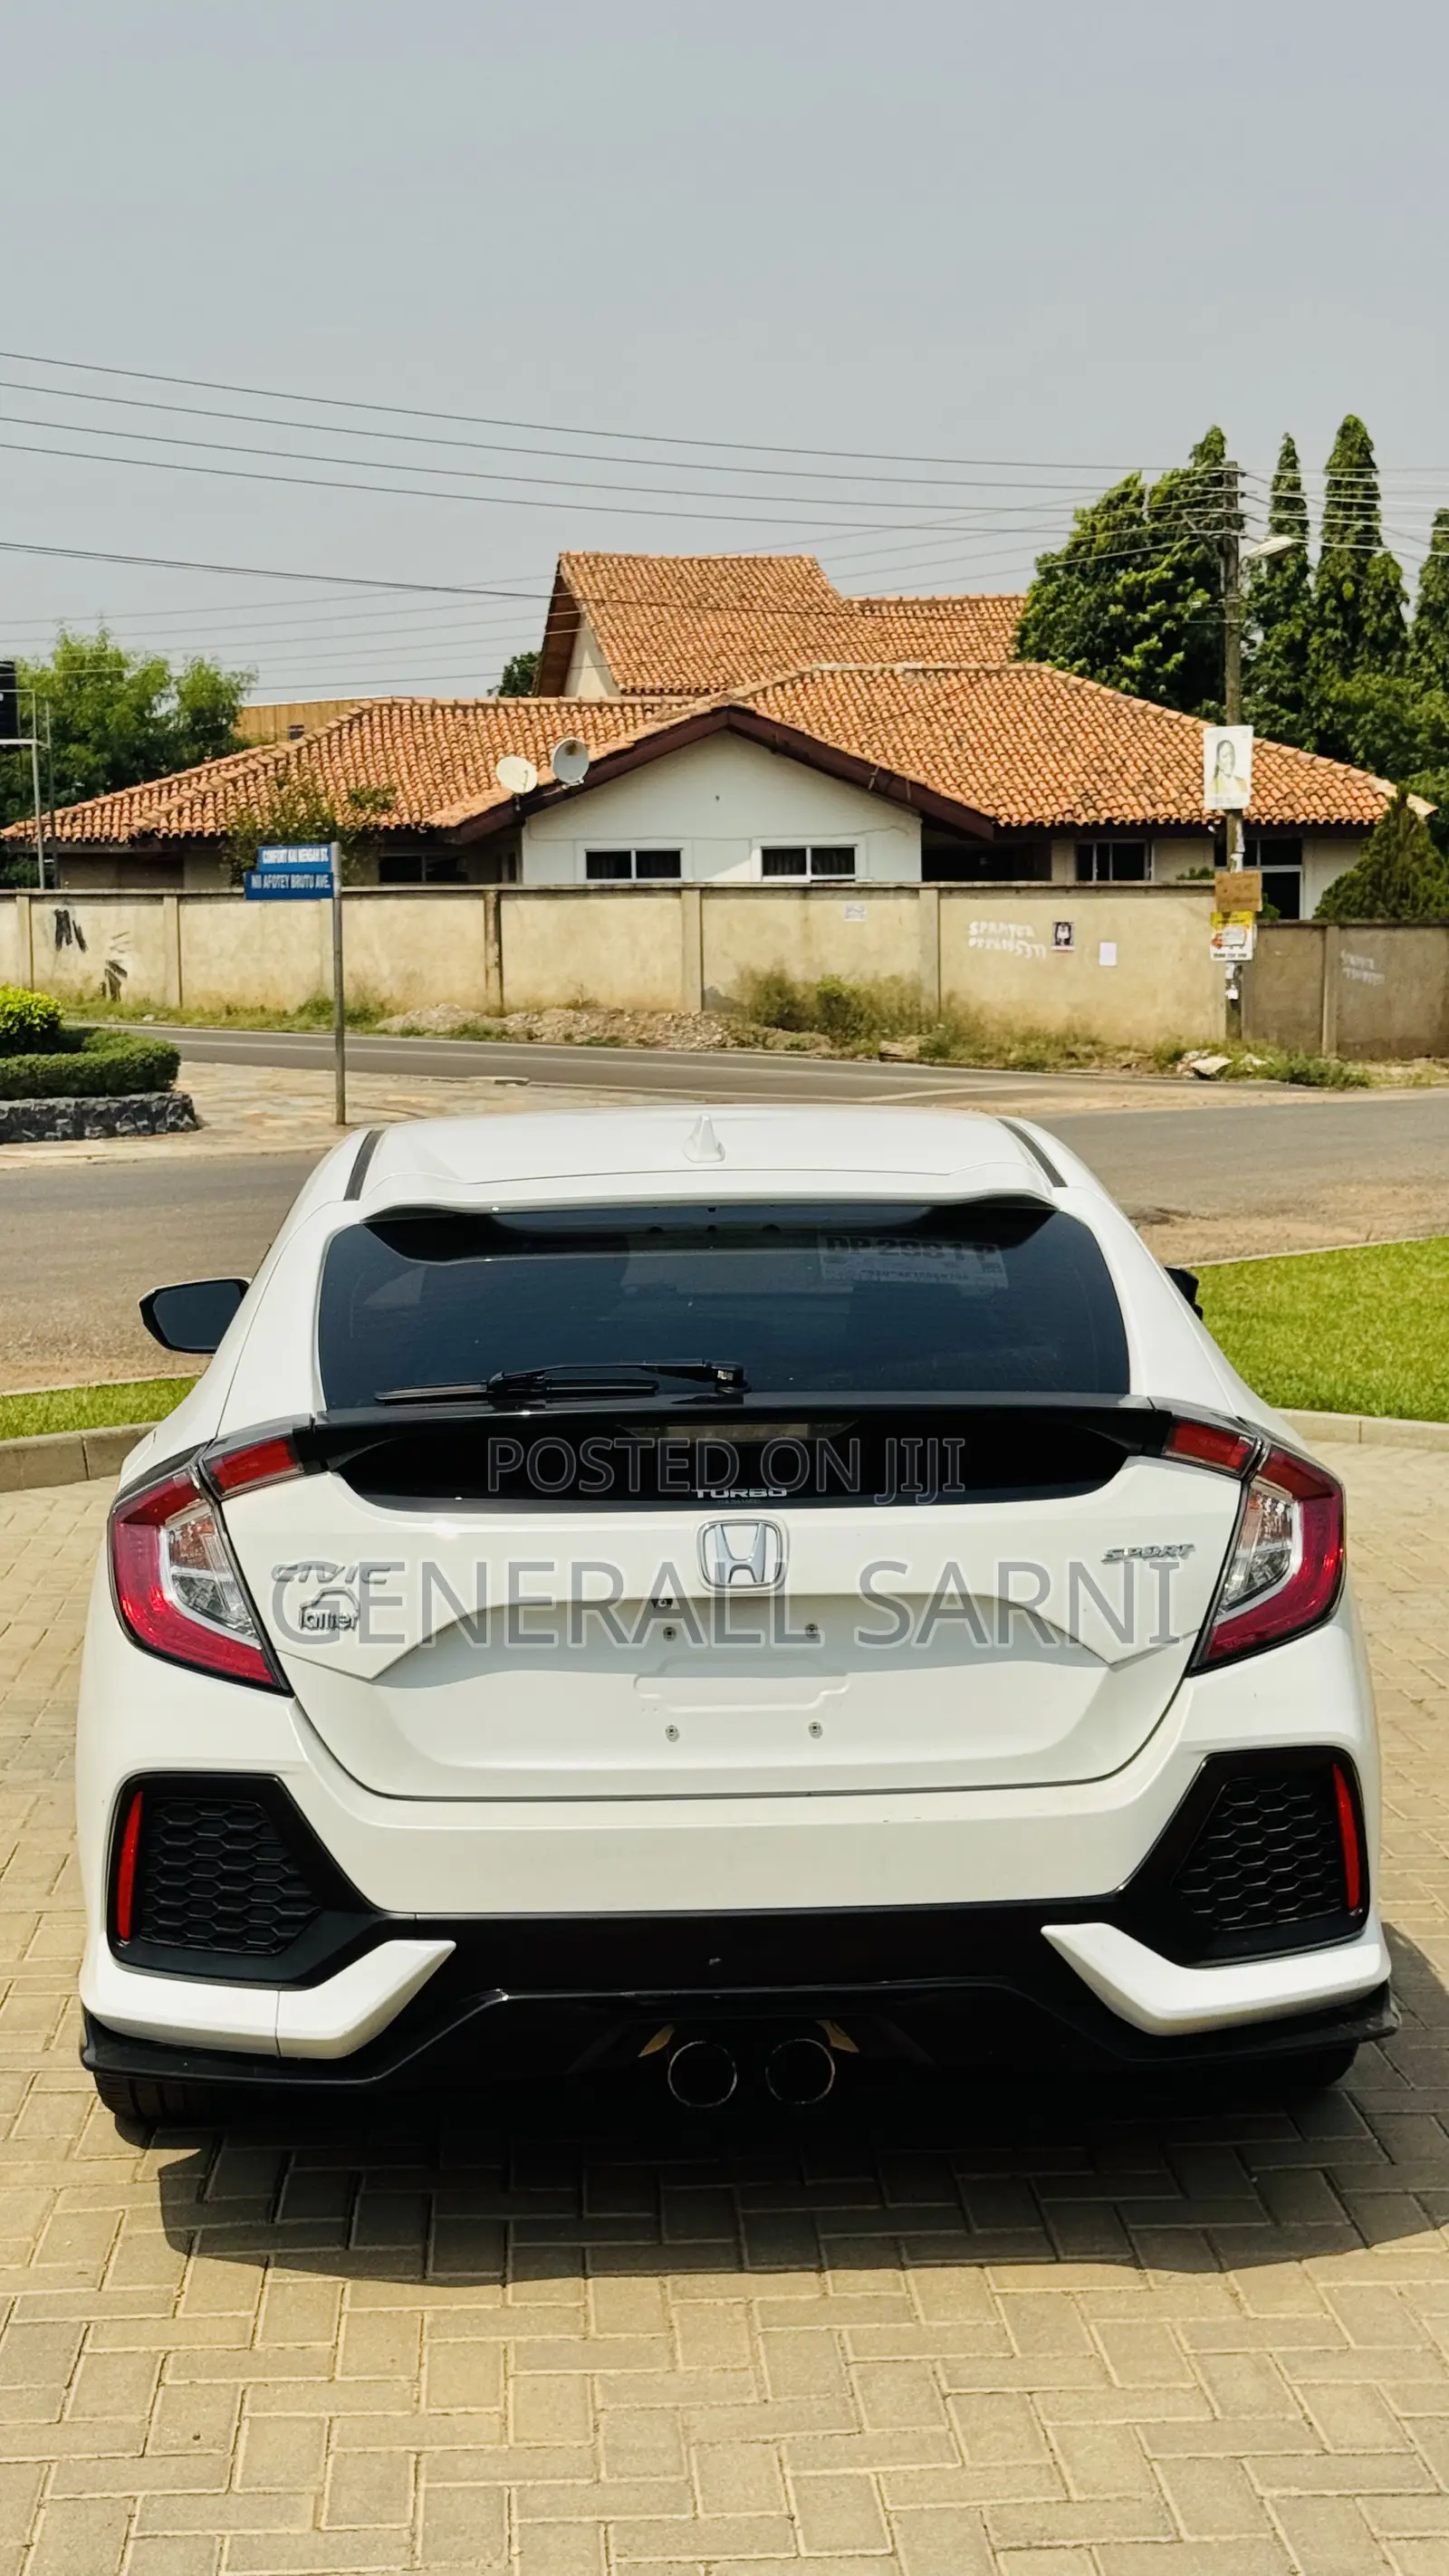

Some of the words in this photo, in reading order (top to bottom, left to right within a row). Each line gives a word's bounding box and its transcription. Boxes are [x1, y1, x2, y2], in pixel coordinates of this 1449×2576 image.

[694, 1489, 788, 1499] TURBO
[1101, 1544, 1195, 1564] SPORT
[272, 1564, 391, 1585] CIVIC
